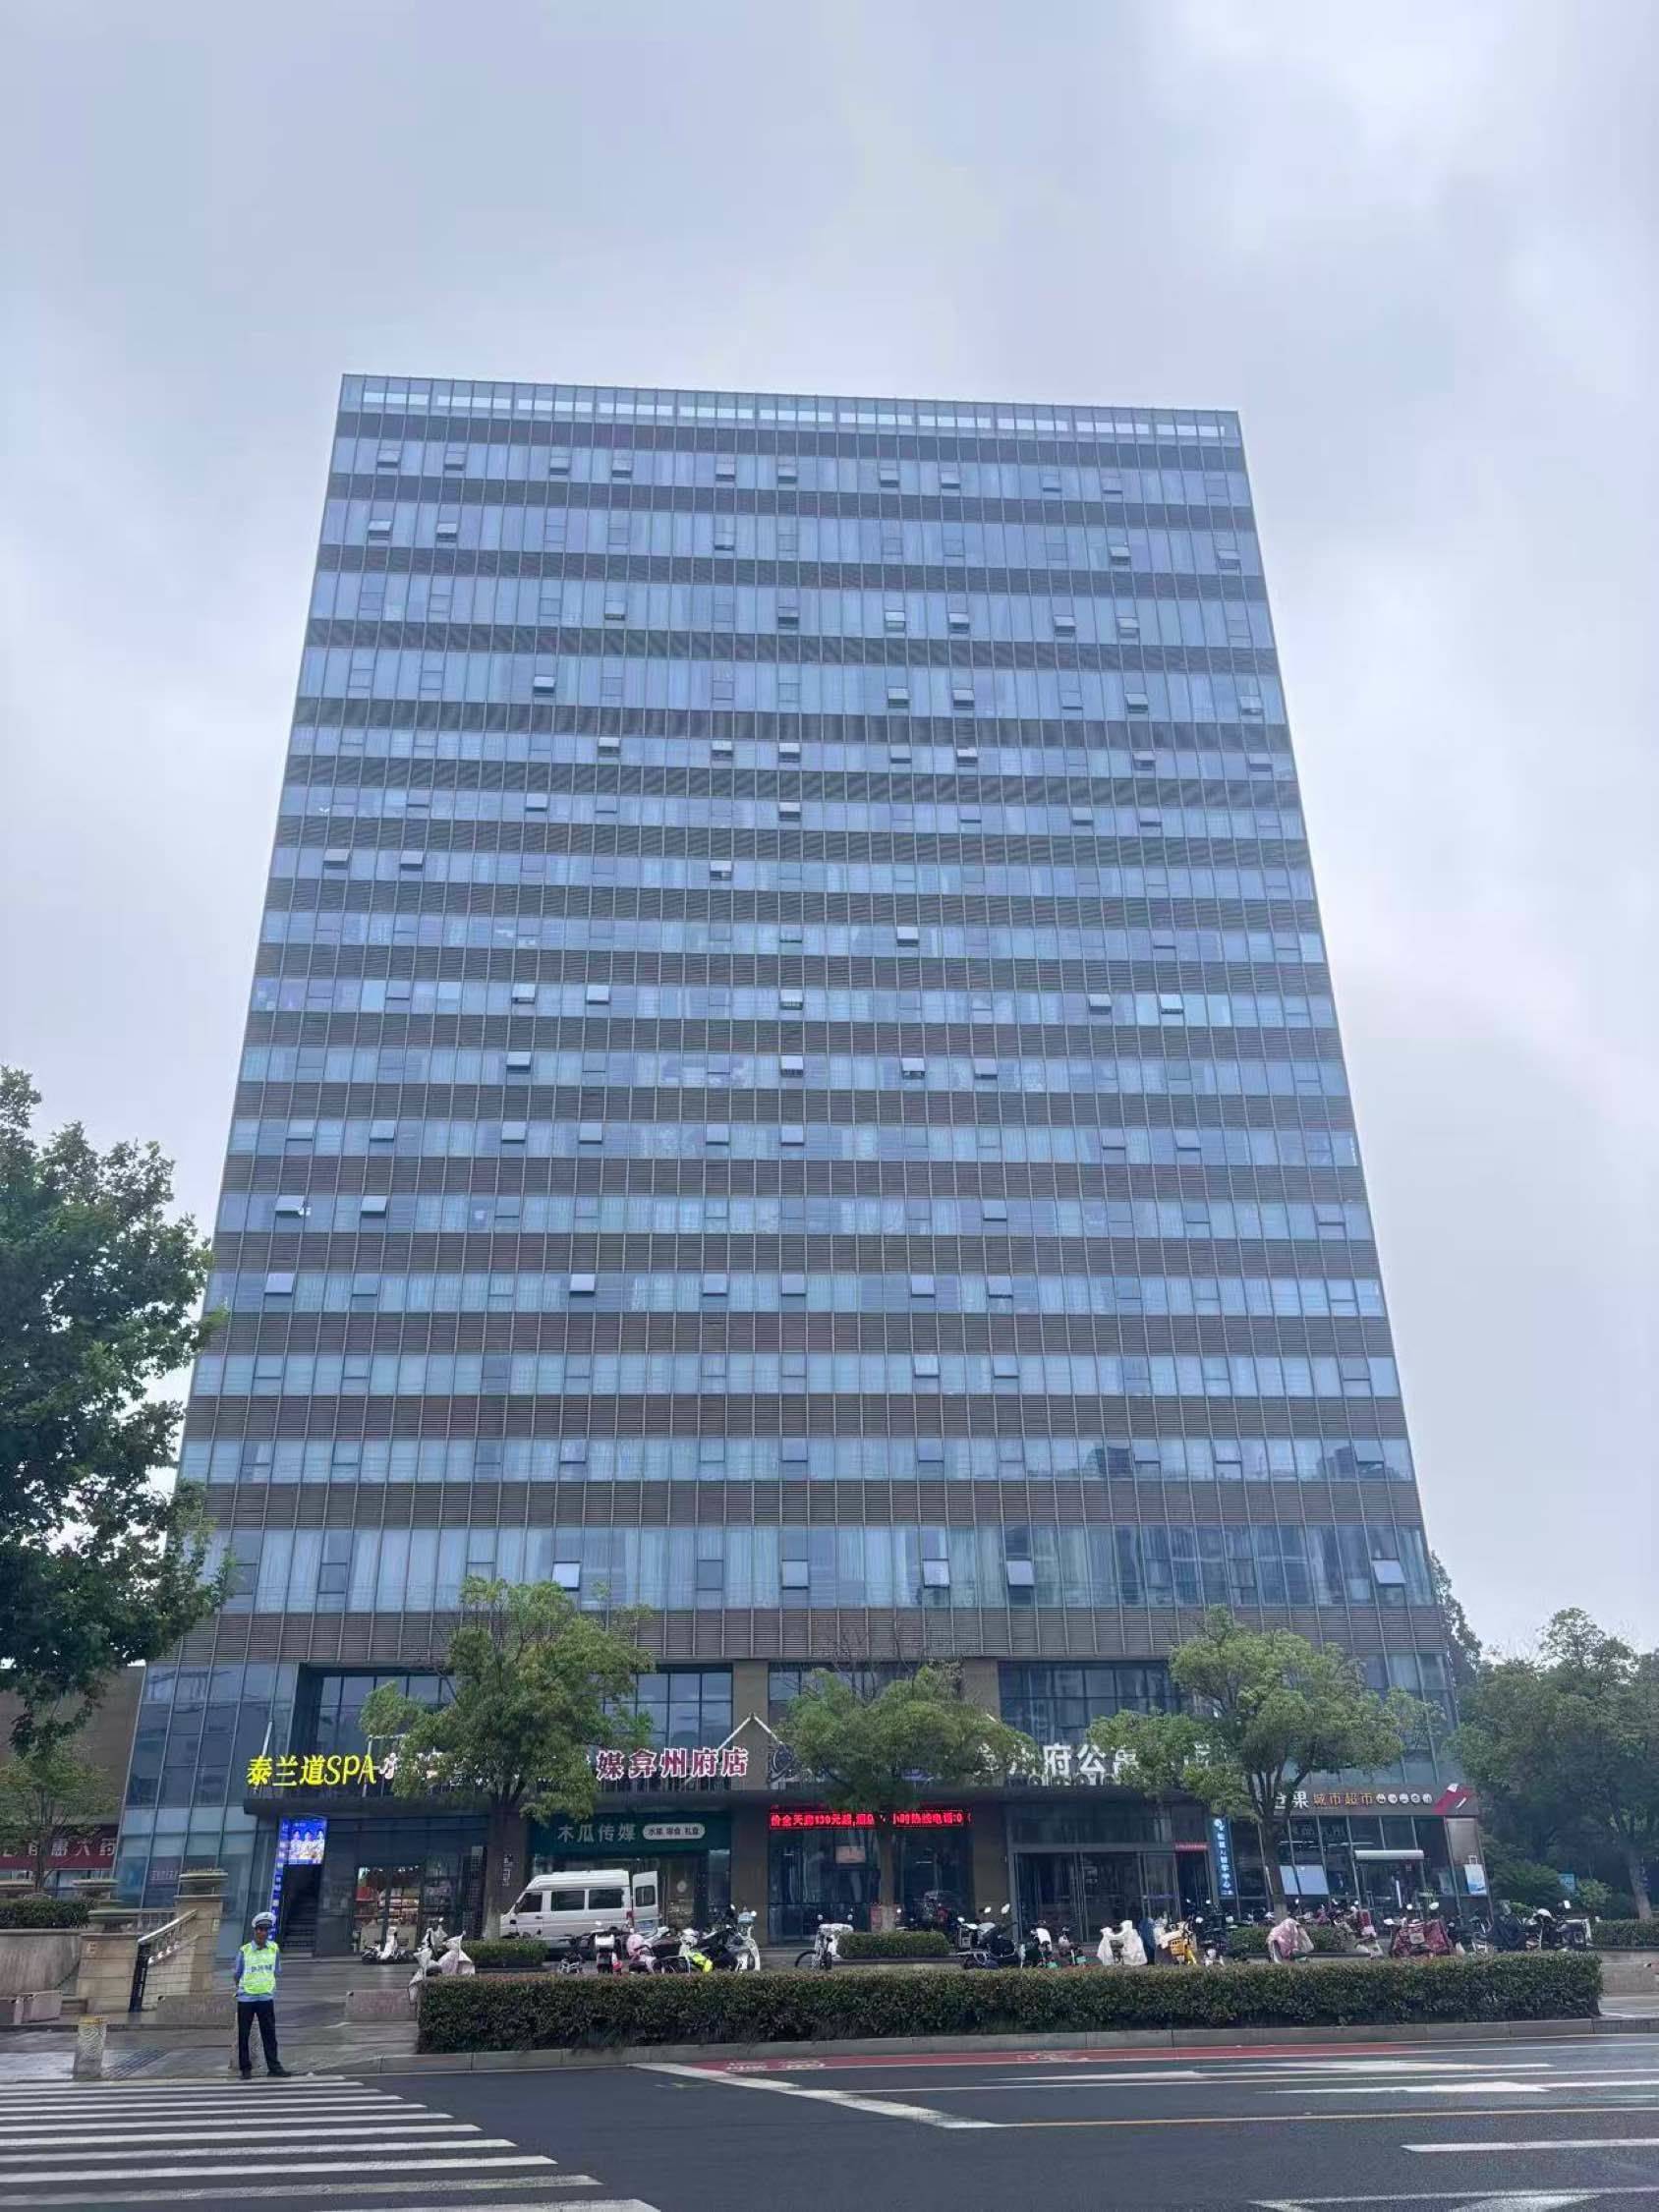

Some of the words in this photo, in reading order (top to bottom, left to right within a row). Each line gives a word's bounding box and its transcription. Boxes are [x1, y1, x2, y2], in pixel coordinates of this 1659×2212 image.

[248, 1753, 376, 1787] 泰兰道SPA
[557, 1823, 636, 1843] 木瓜传媒
